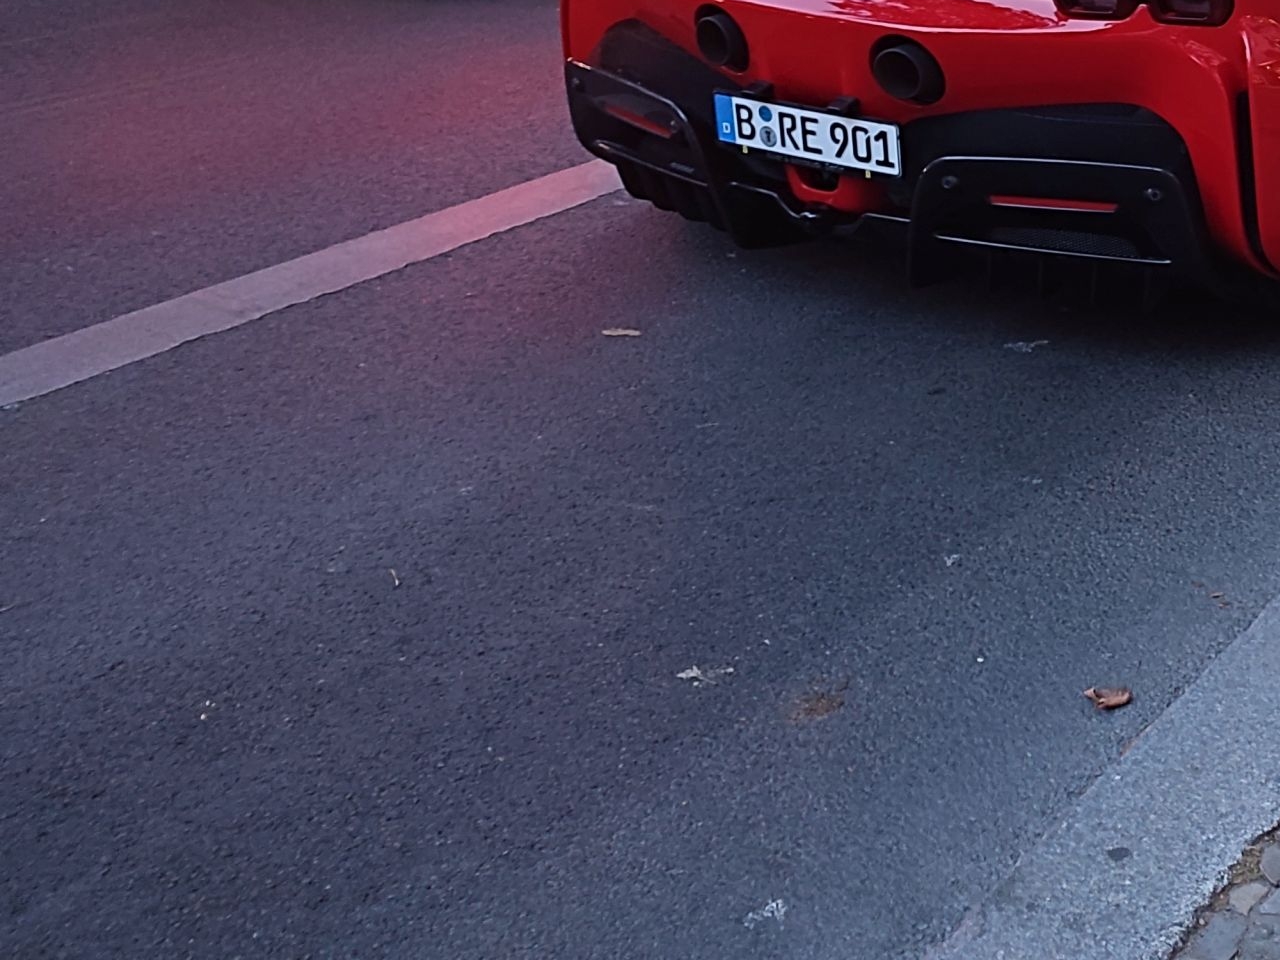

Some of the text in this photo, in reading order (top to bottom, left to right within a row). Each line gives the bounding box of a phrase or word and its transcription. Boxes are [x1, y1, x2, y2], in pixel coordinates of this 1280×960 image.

[735, 103, 756, 141] B
[778, 111, 823, 155] RE
[829, 122, 896, 169] 901
